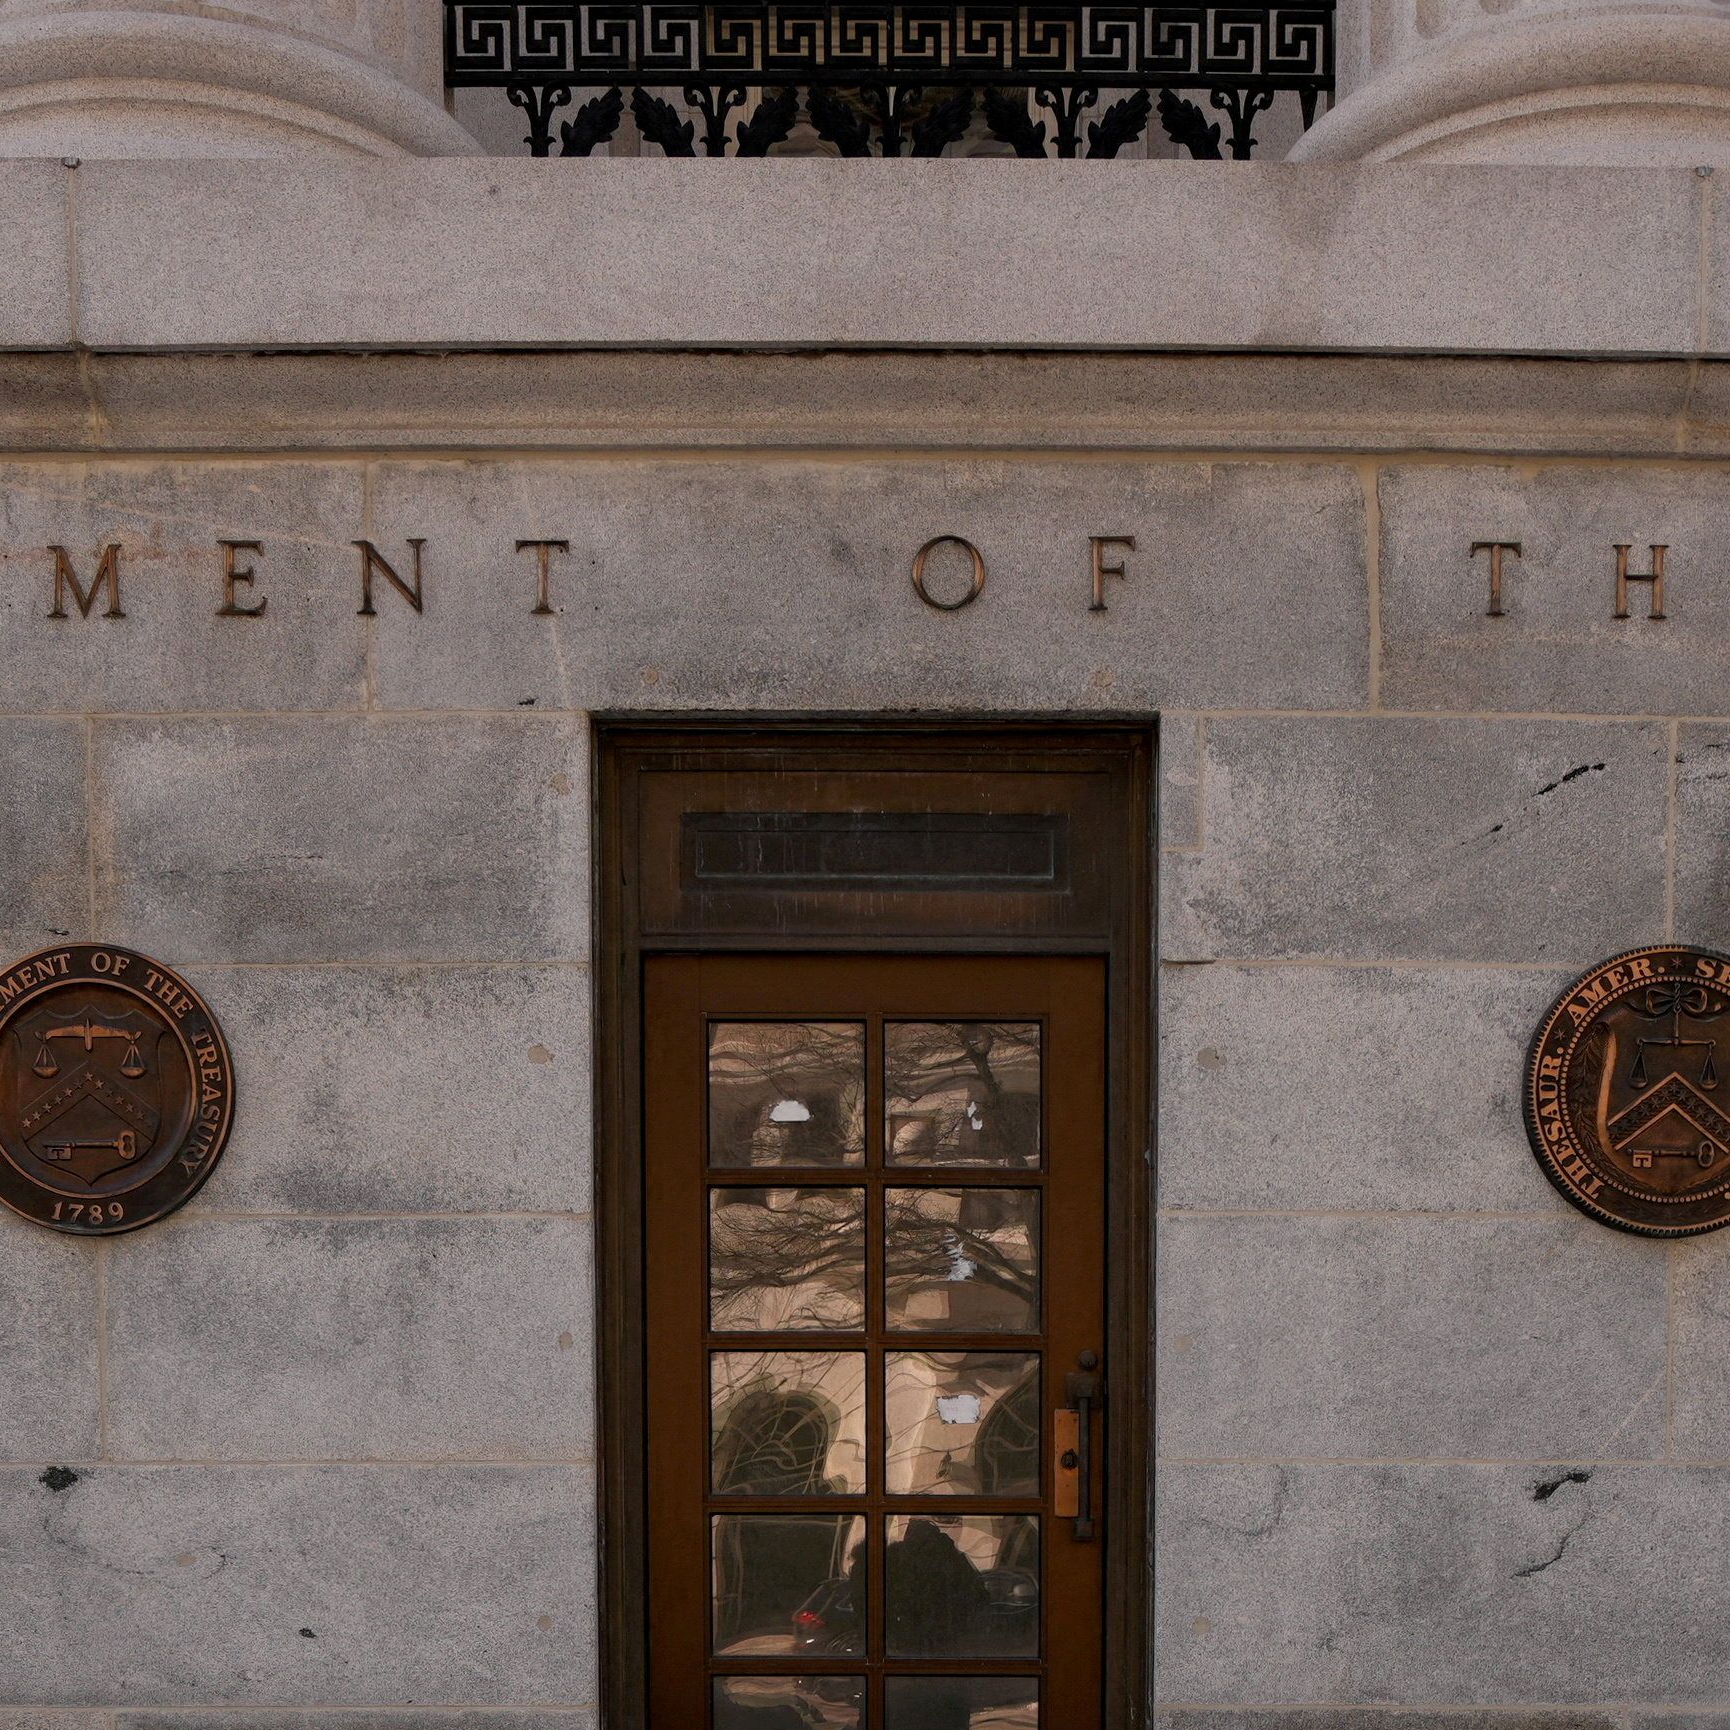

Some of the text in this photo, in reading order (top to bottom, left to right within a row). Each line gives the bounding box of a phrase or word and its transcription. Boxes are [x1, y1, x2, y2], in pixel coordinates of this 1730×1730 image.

[910, 534, 1136, 611] OF
[1567, 957, 1665, 1028] AMER.
[91, 952, 130, 976] OF
[143, 968, 194, 1019] THE
[180, 1025, 222, 1179] TREASURY
[50, 1202, 125, 1225] 1789
